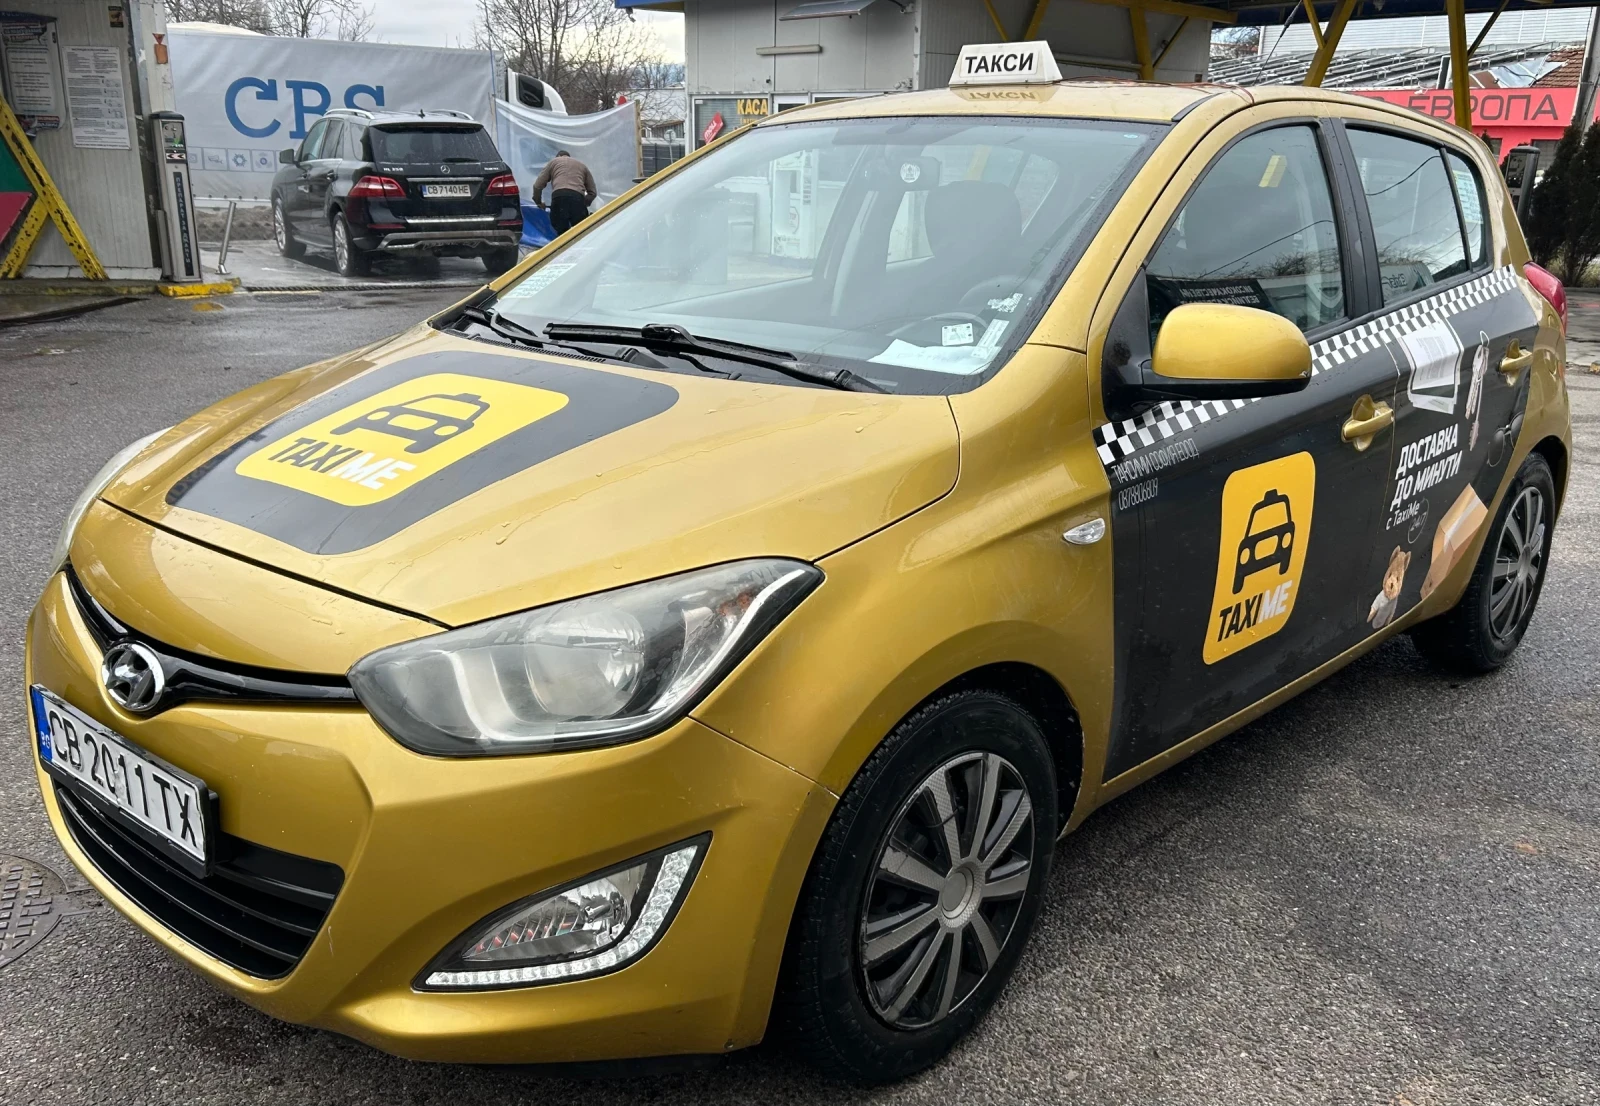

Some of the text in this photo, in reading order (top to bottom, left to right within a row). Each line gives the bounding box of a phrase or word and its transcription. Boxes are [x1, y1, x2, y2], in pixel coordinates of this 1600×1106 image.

[965, 53, 1034, 74] ТАКСИ
[737, 98, 768, 115] КАСА
[175, 177, 185, 218] ПРЕПАРАТ
[1175, 438, 1199, 461] ЕООД
[1395, 423, 1458, 480] ДОСТАВКА
[1390, 450, 1463, 512] ДО МИНУТИ
[1393, 500, 1420, 526] TaxiMe
[40, 731, 51, 749] BG
